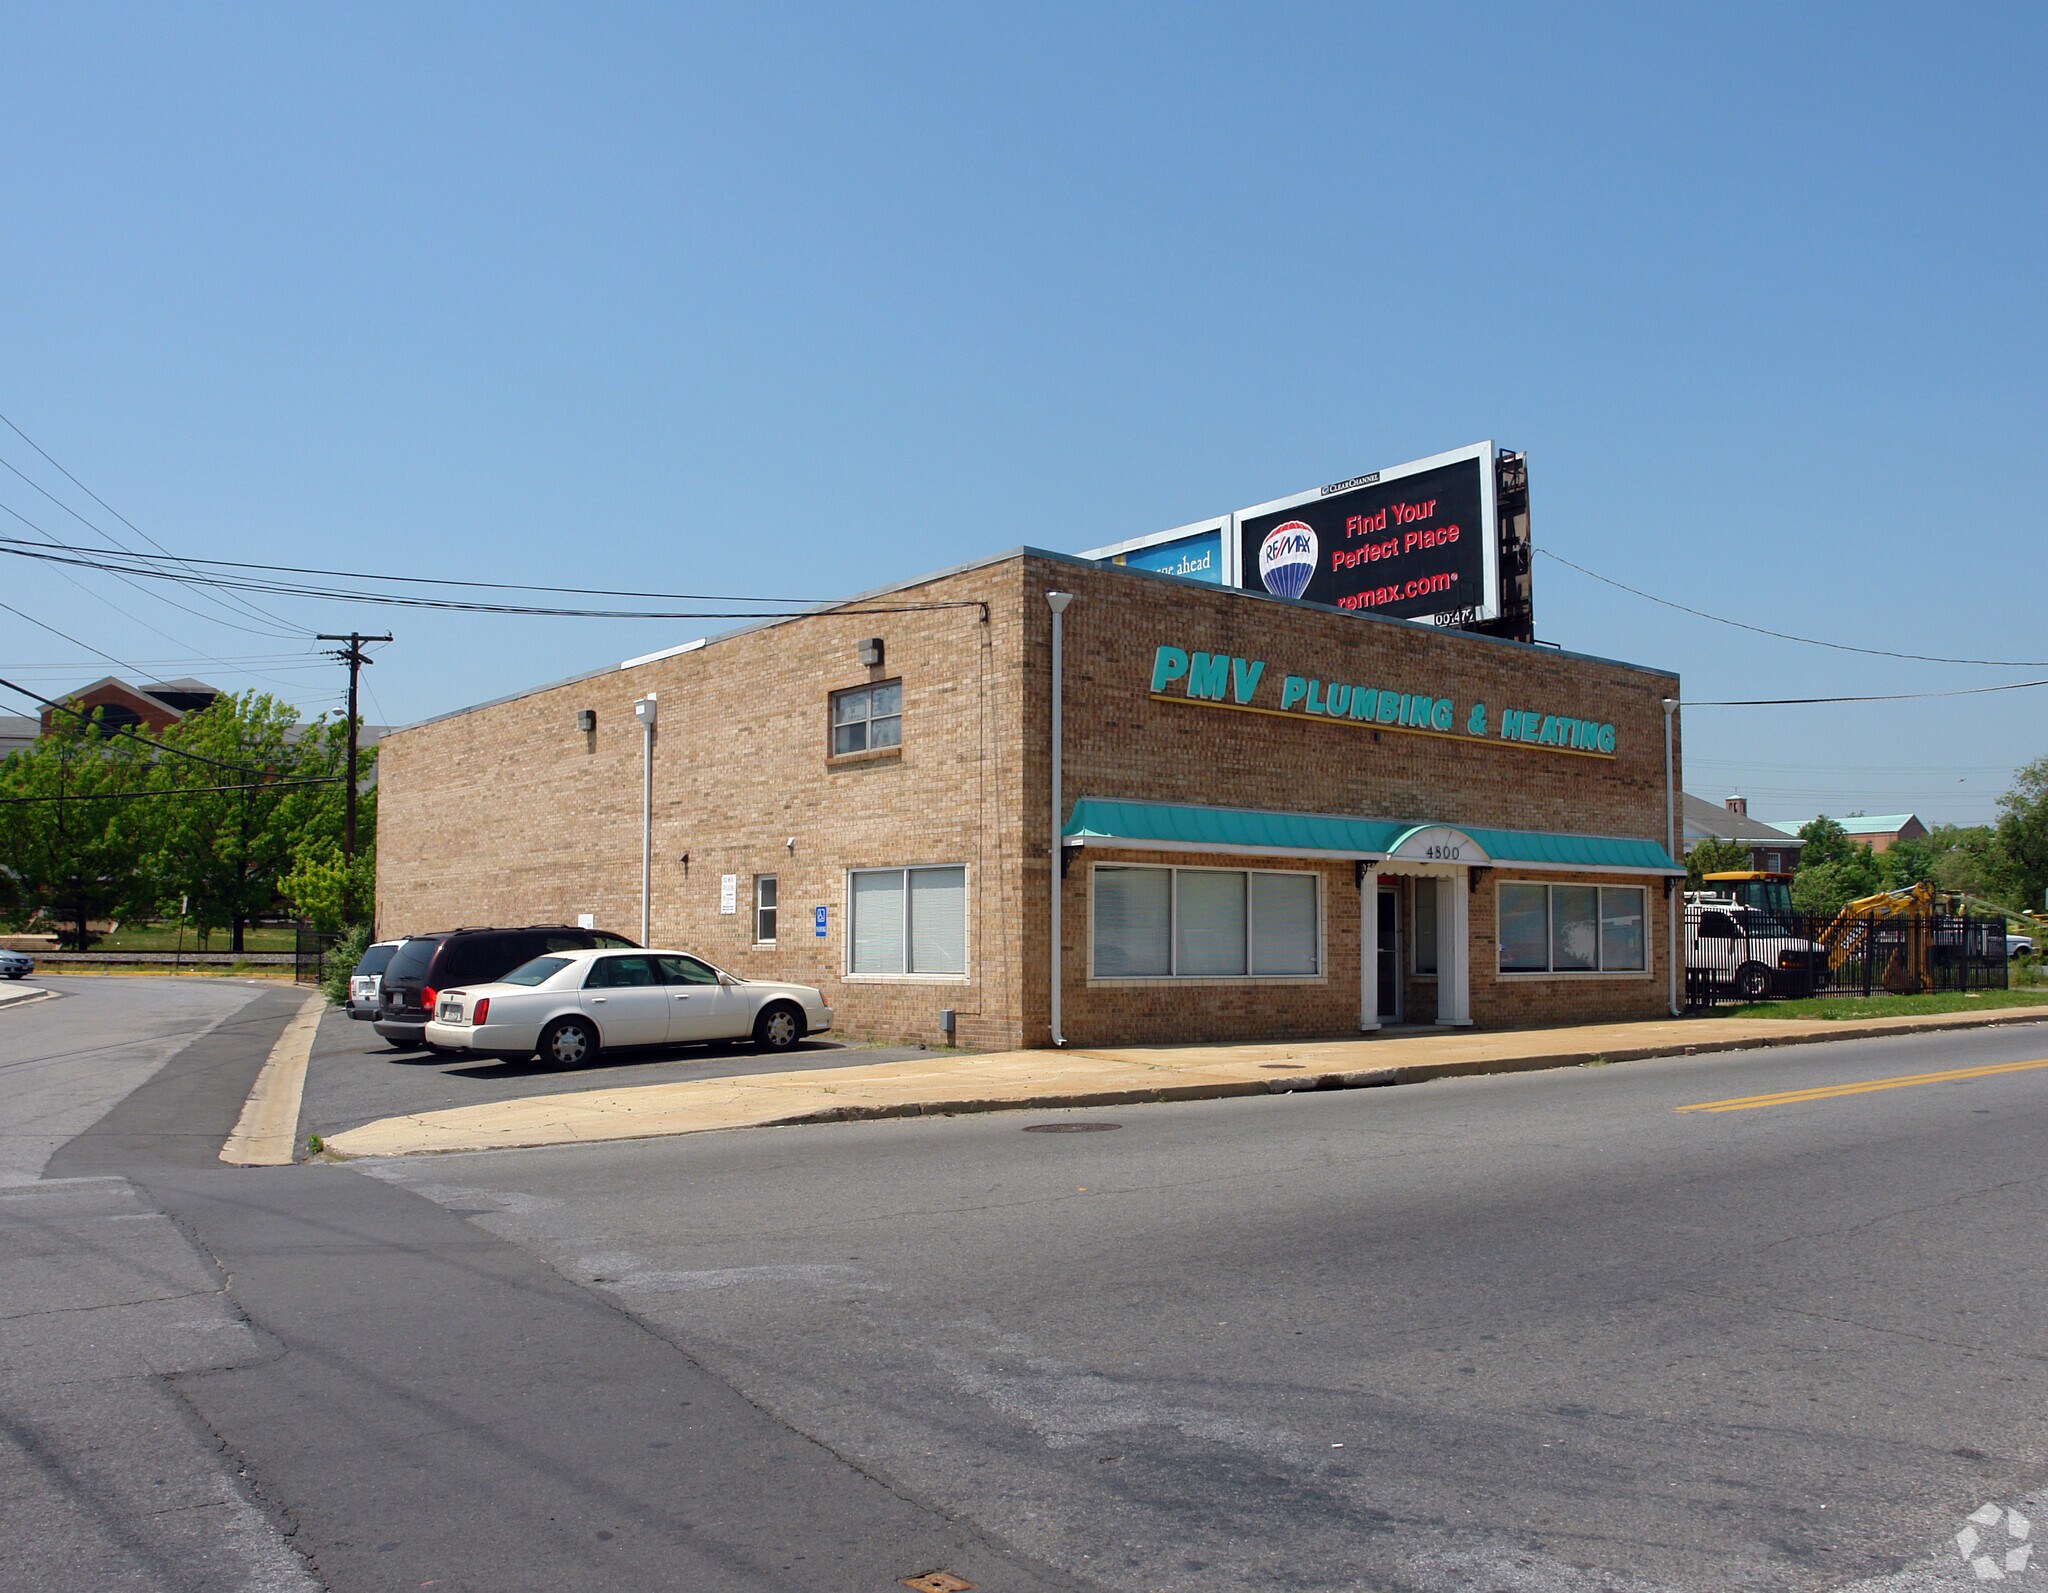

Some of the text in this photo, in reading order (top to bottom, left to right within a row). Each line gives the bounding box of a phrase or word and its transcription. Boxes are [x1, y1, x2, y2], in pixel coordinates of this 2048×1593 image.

[1345, 499, 1437, 539] Find Your
[1177, 550, 1211, 576] ahead
[1266, 535, 1311, 563] RE/MAX
[1331, 524, 1460, 573] Perfect Place
[1150, 645, 1616, 754] PMV PLUMBING & HEATING
[1426, 845, 1460, 860] 4800
